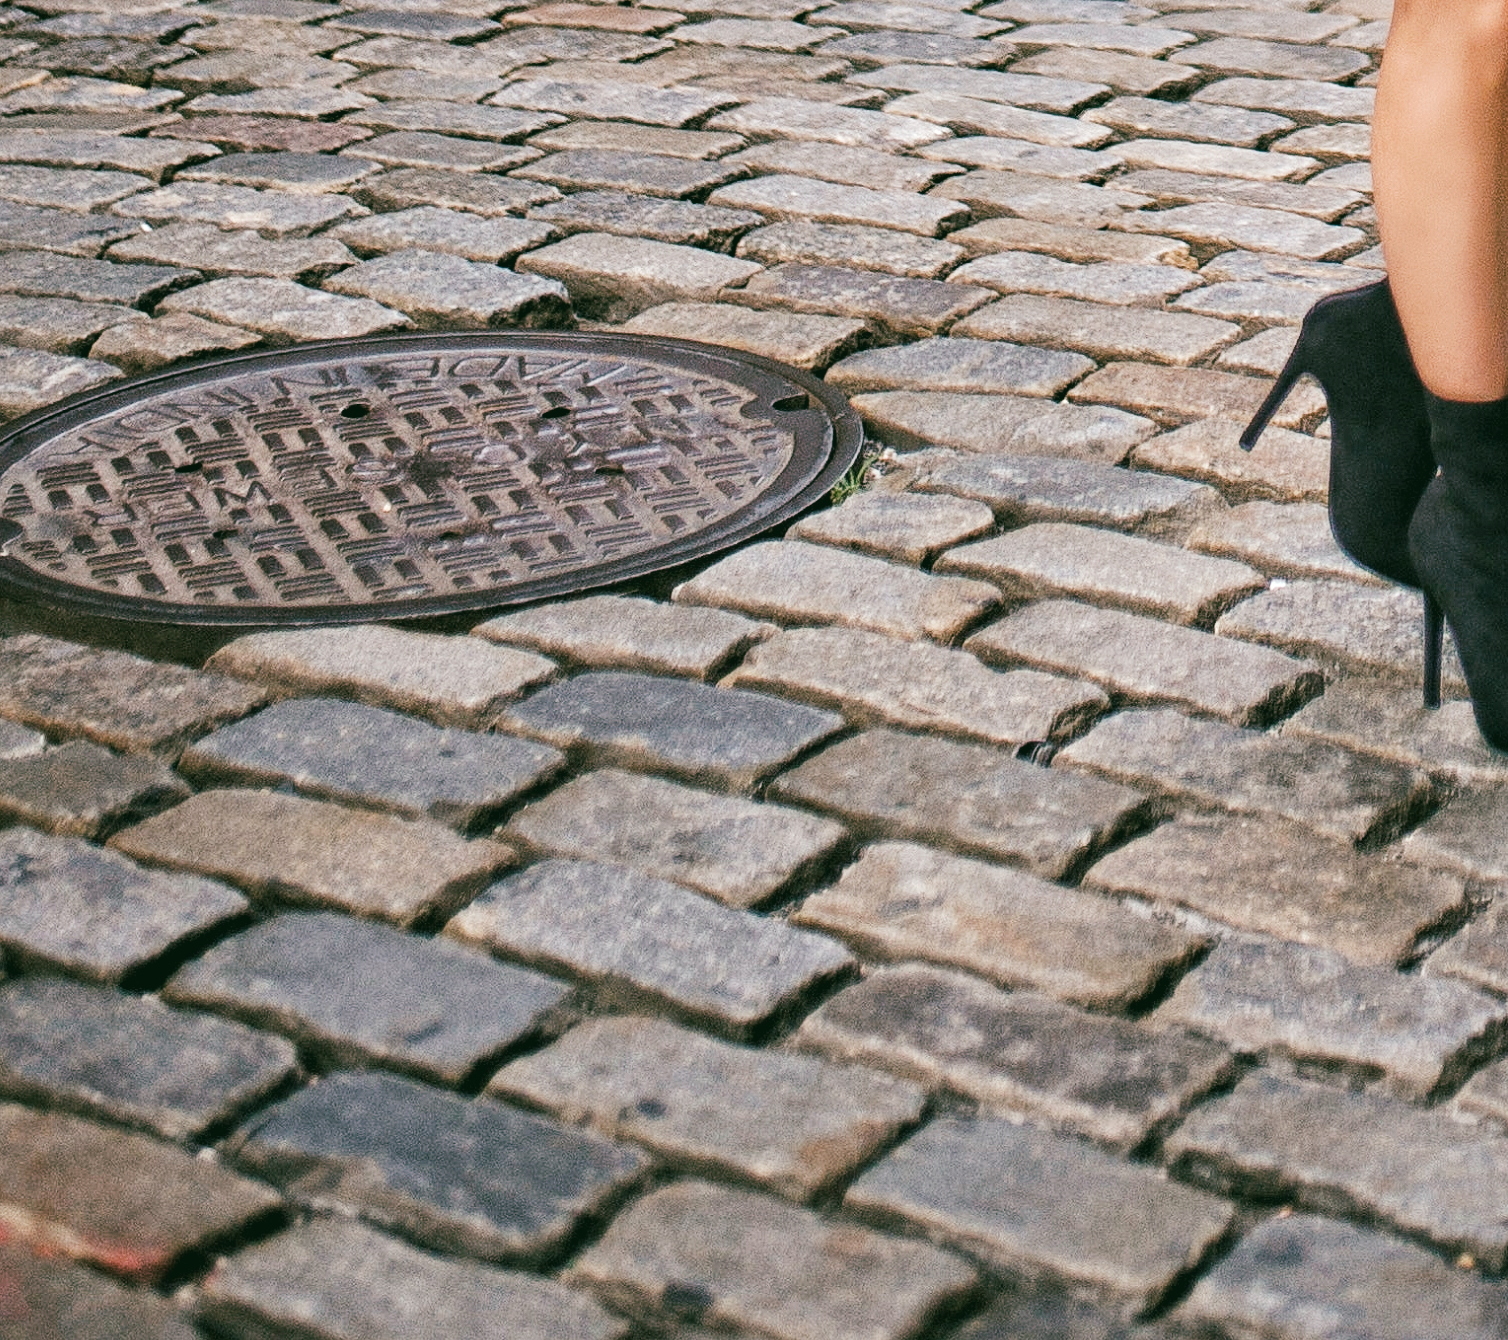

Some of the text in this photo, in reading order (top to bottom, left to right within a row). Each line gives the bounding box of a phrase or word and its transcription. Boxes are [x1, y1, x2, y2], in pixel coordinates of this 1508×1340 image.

[49, 356, 627, 457] MADE IN INDIA
